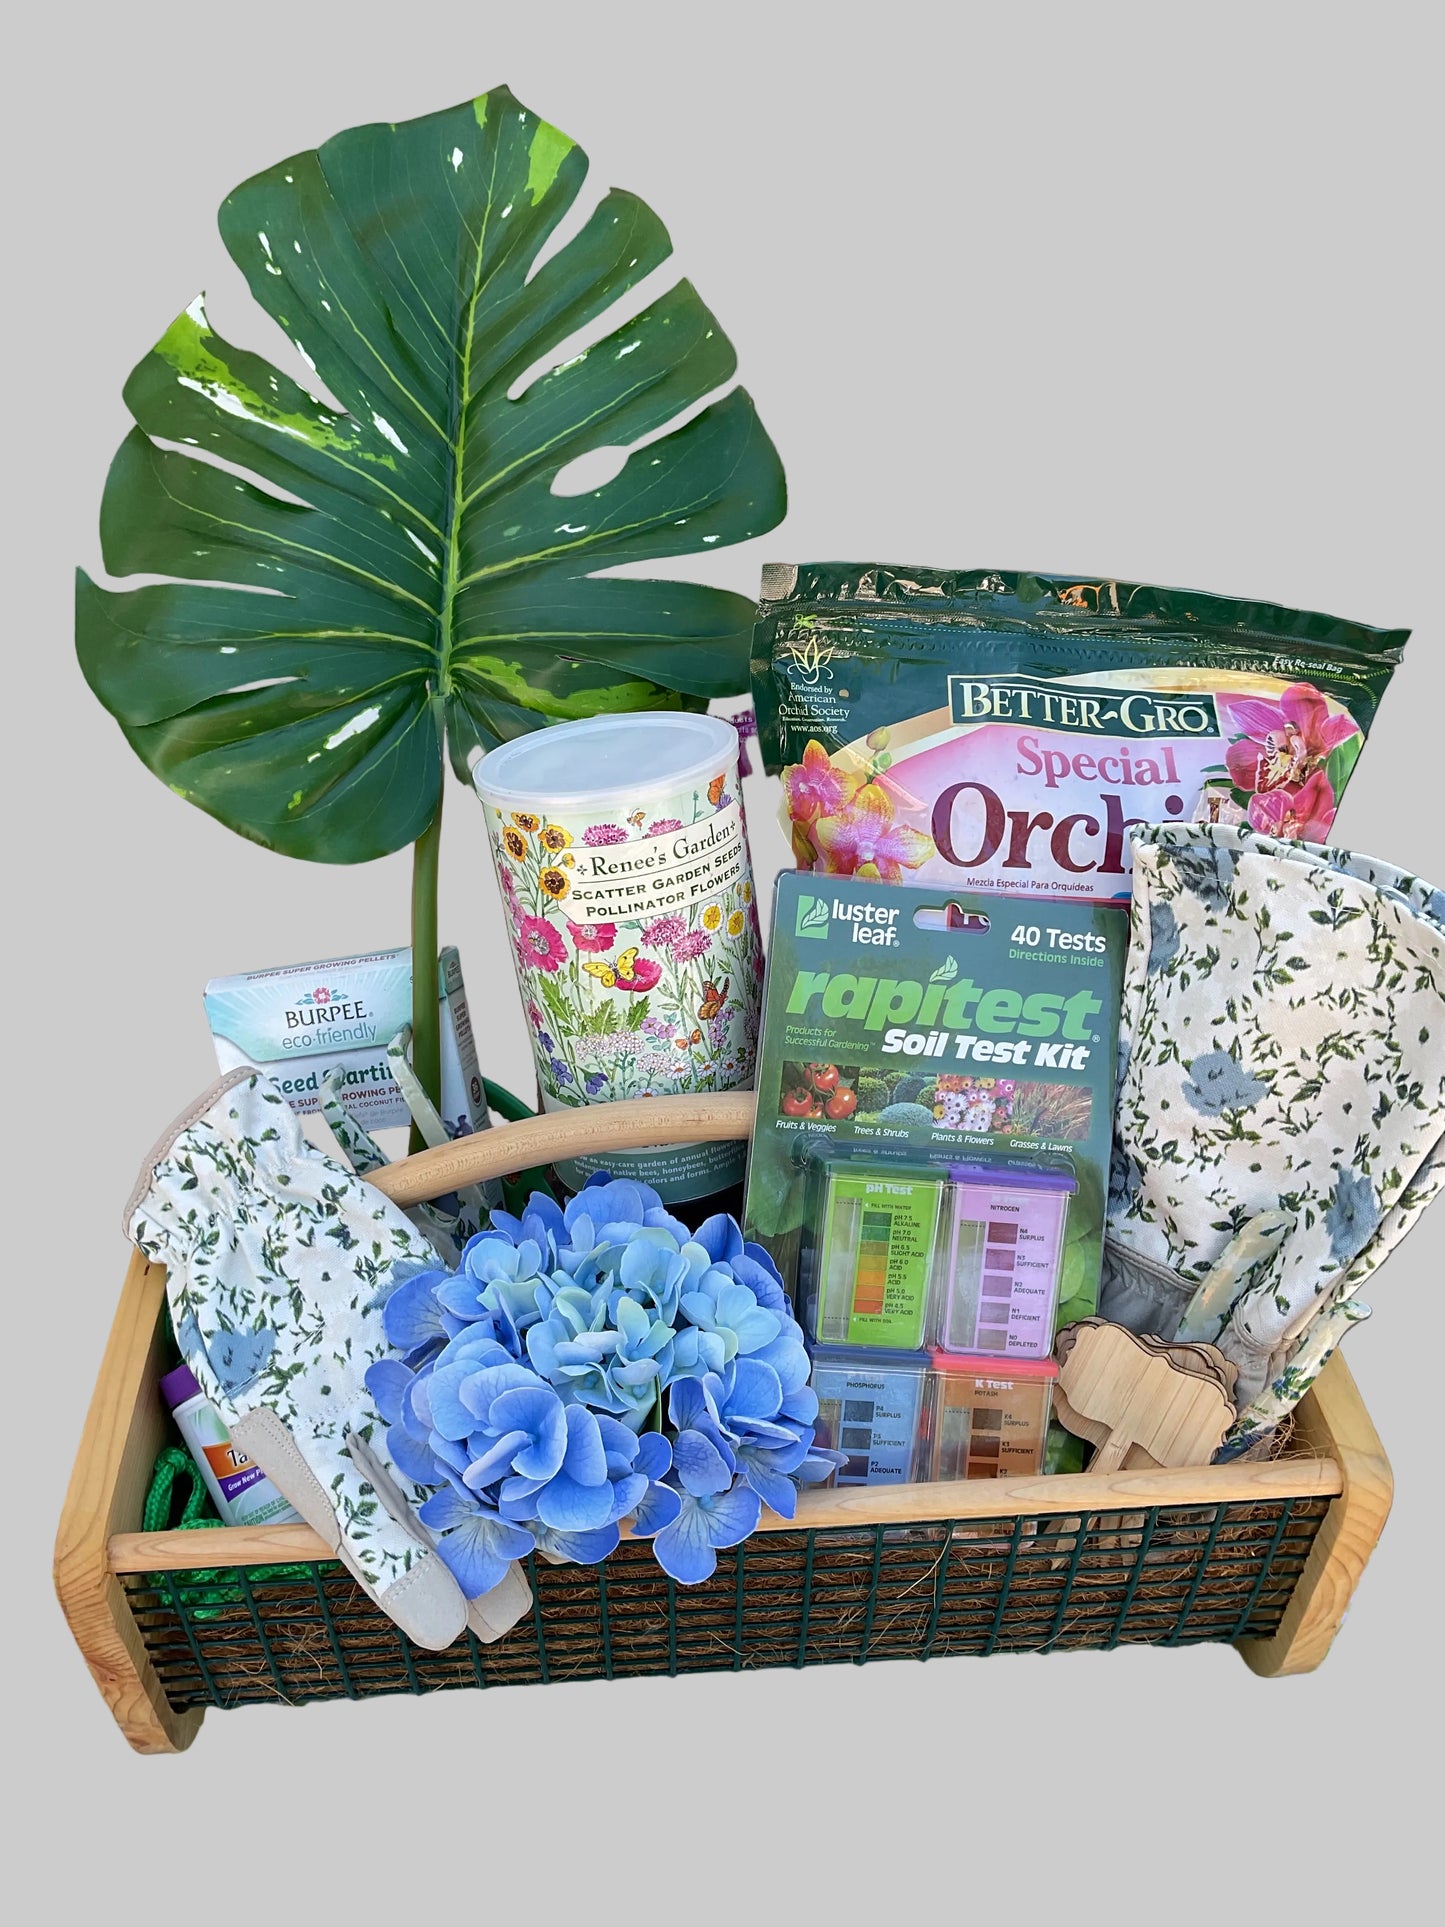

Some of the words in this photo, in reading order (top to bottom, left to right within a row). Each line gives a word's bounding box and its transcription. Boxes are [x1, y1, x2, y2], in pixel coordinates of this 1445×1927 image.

[1274, 656, 1294, 668] Easy
[1294, 659, 1326, 670] Re-seal
[1326, 664, 1343, 674] Bag
[790, 682, 822, 692] Endorsed
[824, 686, 833, 694] by
[788, 691, 836, 704] American
[778, 704, 808, 716] Orchid
[811, 704, 850, 718] Society
[791, 725, 838, 734] www.aos.org
[1016, 736, 1181, 788] Special
[590, 847, 667, 876] Renee's
[673, 823, 730, 859] Garden
[572, 884, 646, 900] SCATTER
[652, 863, 711, 890] GARDEN
[715, 842, 742, 868] SEEDS
[586, 892, 684, 917] POLLINATOR
[691, 863, 740, 896] FLOWERS
[967, 878, 994, 887] Mezcla
[996, 879, 1028, 888] Especial
[1031, 881, 1048, 890] Para
[1051, 882, 1094, 892] Orquídeas
[832, 899, 900, 924] luster
[852, 922, 897, 946] leaf
[1011, 925, 1040, 946] 40
[1046, 928, 1106, 952] Tests
[1008, 948, 1067, 964] Directions
[1070, 954, 1104, 968] Inside
[246, 971, 281, 980] BURPEE
[282, 966, 311, 974] SUPER
[314, 960, 356, 970] GROWING
[358, 954, 396, 964] PELLETS
[786, 966, 1102, 1040] rapitest
[285, 1001, 366, 1028] BURPEE
[786, 1026, 822, 1036] Products
[824, 1028, 836, 1037] for
[784, 1036, 828, 1047] Successful
[828, 1040, 870, 1051] Gardening
[882, 1028, 949, 1057] Soil
[955, 1034, 1032, 1065] Test
[1034, 1042, 1090, 1070] Kit
[342, 1088, 386, 1101] ROWING
[358, 1098, 392, 1108] COCONUT
[776, 1120, 798, 1130] Fruits
[807, 1122, 836, 1132] Veggies
[854, 1126, 874, 1135] Trees
[882, 1128, 910, 1138] Shrubs
[931, 1132, 956, 1142] Plants
[964, 1136, 994, 1146] Flowers
[1010, 1139, 1038, 1150] Grasses
[1040, 1142, 1046, 1150] &
[1048, 1142, 1072, 1152] Lawns
[600, 1160, 634, 1168] easy-care
[638, 1159, 667, 1169] garden
[670, 1157, 678, 1165] of
[682, 1150, 708, 1163] annual
[639, 1168, 660, 1177] bees,
[662, 1161, 706, 1174] honeybees,
[670, 1174, 685, 1182] and
[686, 1168, 712, 1178] forms.
[866, 1183, 883, 1194] pH
[885, 1184, 913, 1196] Test
[975, 1380, 984, 1388] K
[986, 1380, 1014, 1390] Test
[228, 1480, 242, 1491] Grow
[242, 1474, 255, 1484] New
